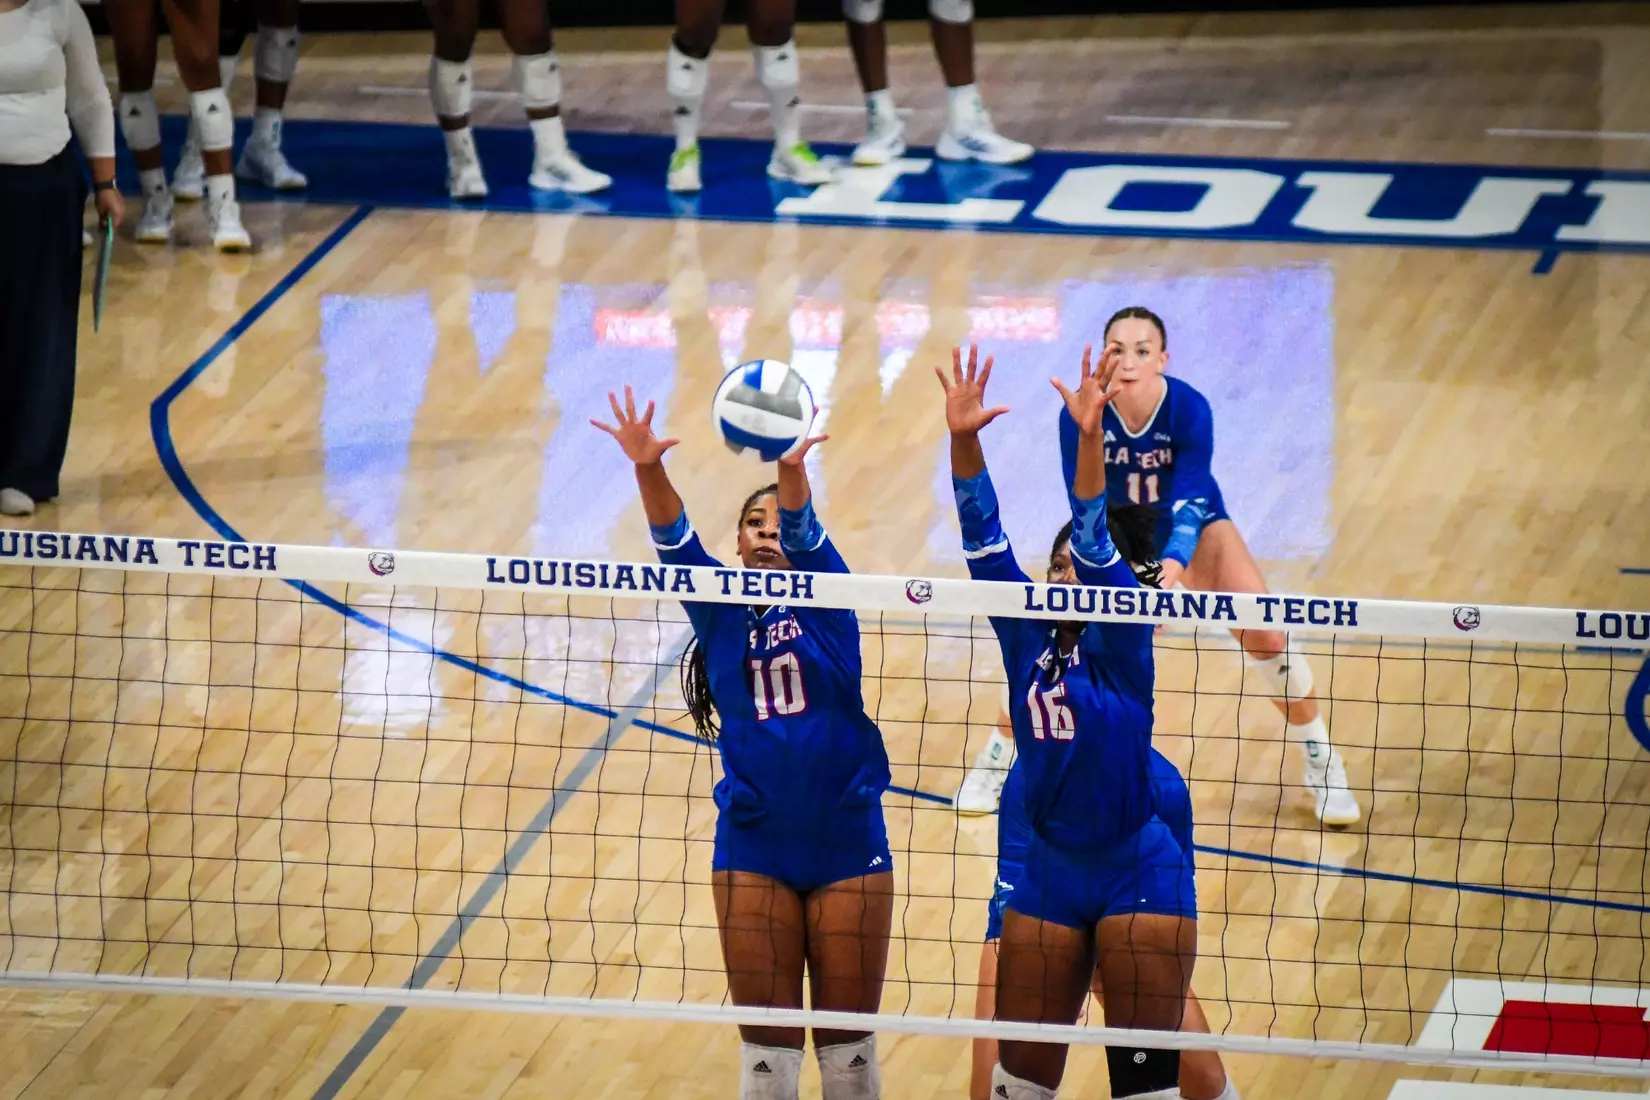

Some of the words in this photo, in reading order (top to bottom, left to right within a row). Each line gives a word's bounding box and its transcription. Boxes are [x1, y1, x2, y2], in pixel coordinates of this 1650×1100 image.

[1104, 446, 1130, 464] LA
[1126, 472, 1160, 505] 11
[177, 541, 277, 571] TECH
[487, 557, 696, 593] LOUISIANA
[714, 569, 815, 599] TECH
[1024, 585, 1238, 621] LOUISIANA
[1256, 597, 1359, 627] TECH
[1575, 611, 1650, 641] LOU
[751, 651, 807, 722] 10
[1027, 681, 1076, 742] 16
